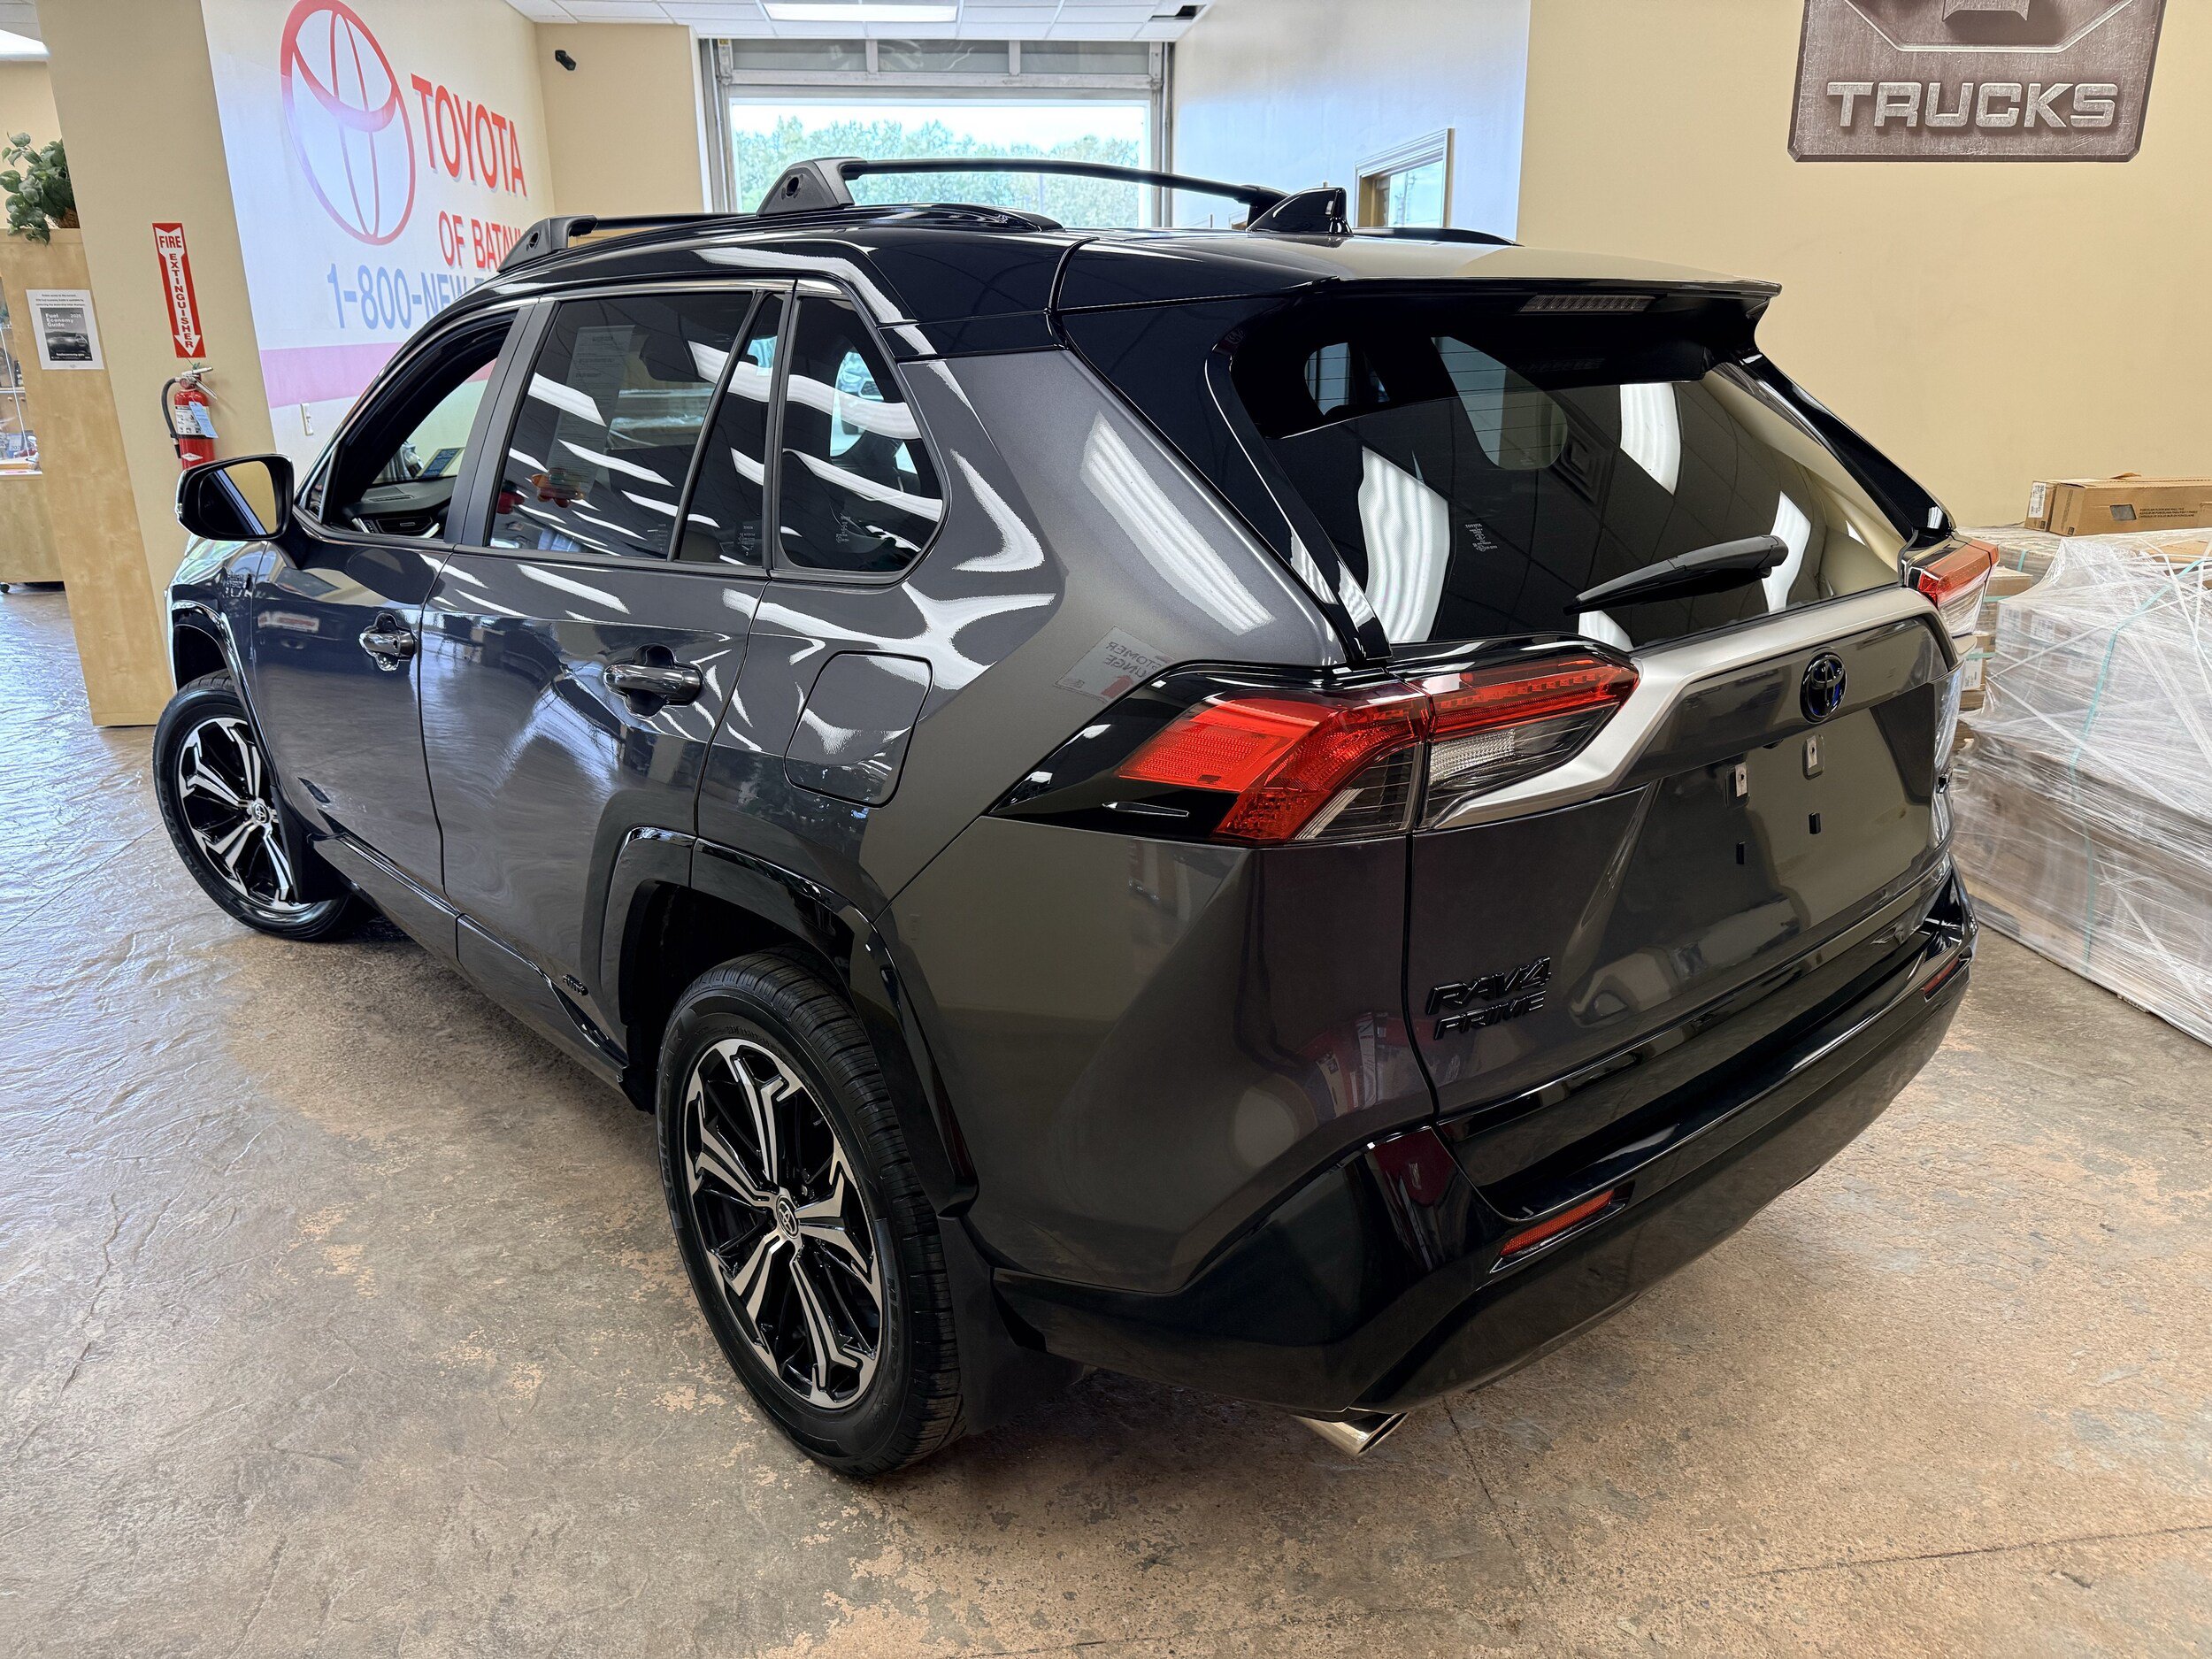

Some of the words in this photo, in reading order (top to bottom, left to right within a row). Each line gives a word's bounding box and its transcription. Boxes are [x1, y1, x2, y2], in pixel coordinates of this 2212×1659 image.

[1826, 81, 2118, 127] TRUCKS
[411, 73, 526, 196] TOYOTA
[158, 235, 182, 249] FIRE
[438, 211, 465, 267] OF
[471, 218, 520, 270] BATA
[169, 253, 194, 348] EXTINGUISHER
[1425, 956, 1552, 1015] RAV4
[1433, 990, 1547, 1041] PRIME
